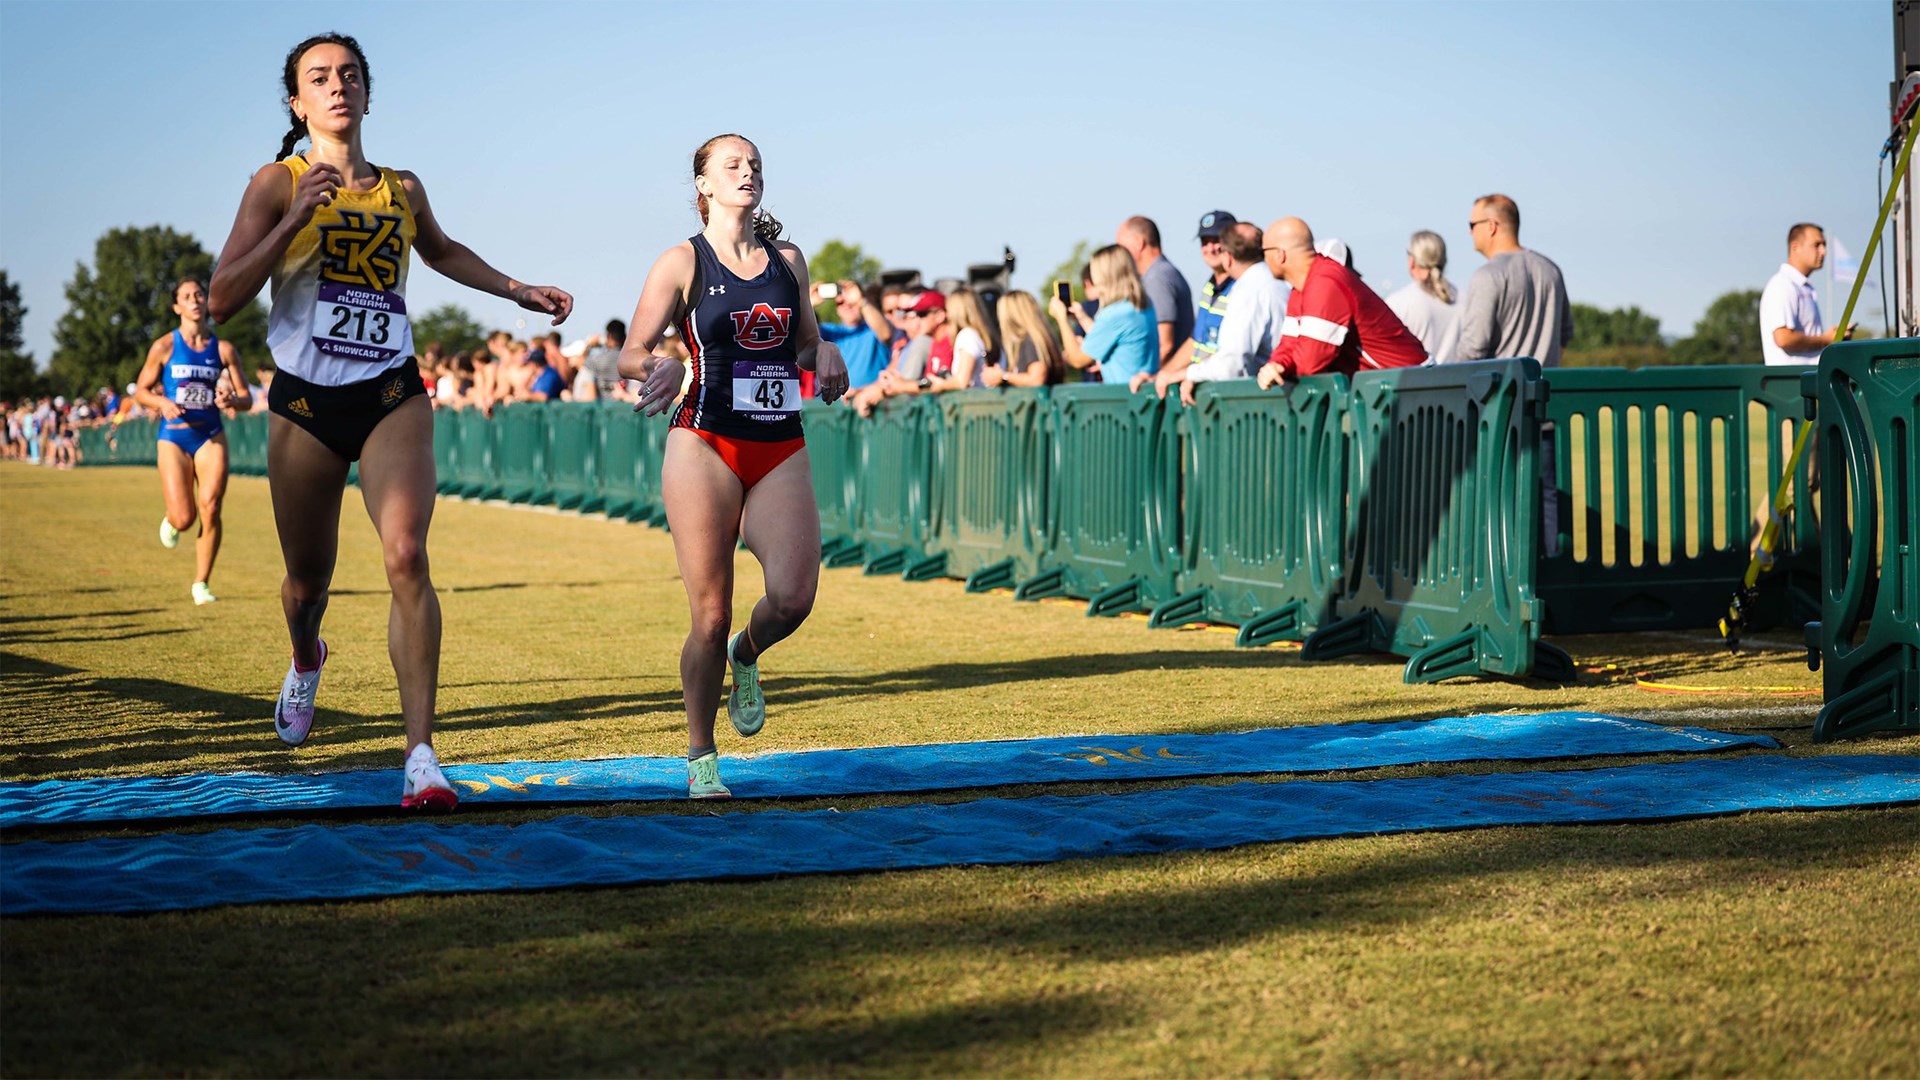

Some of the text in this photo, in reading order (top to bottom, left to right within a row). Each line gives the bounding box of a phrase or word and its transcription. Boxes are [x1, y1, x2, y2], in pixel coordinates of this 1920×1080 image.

[337, 295, 391, 310] ALABAMA
[346, 289, 385, 302] NORTH
[329, 305, 391, 345] 213
[333, 344, 380, 359] SHOWCASE
[184, 388, 207, 402] 228
[754, 380, 784, 409] 43
[287, 402, 314, 418] adidas
